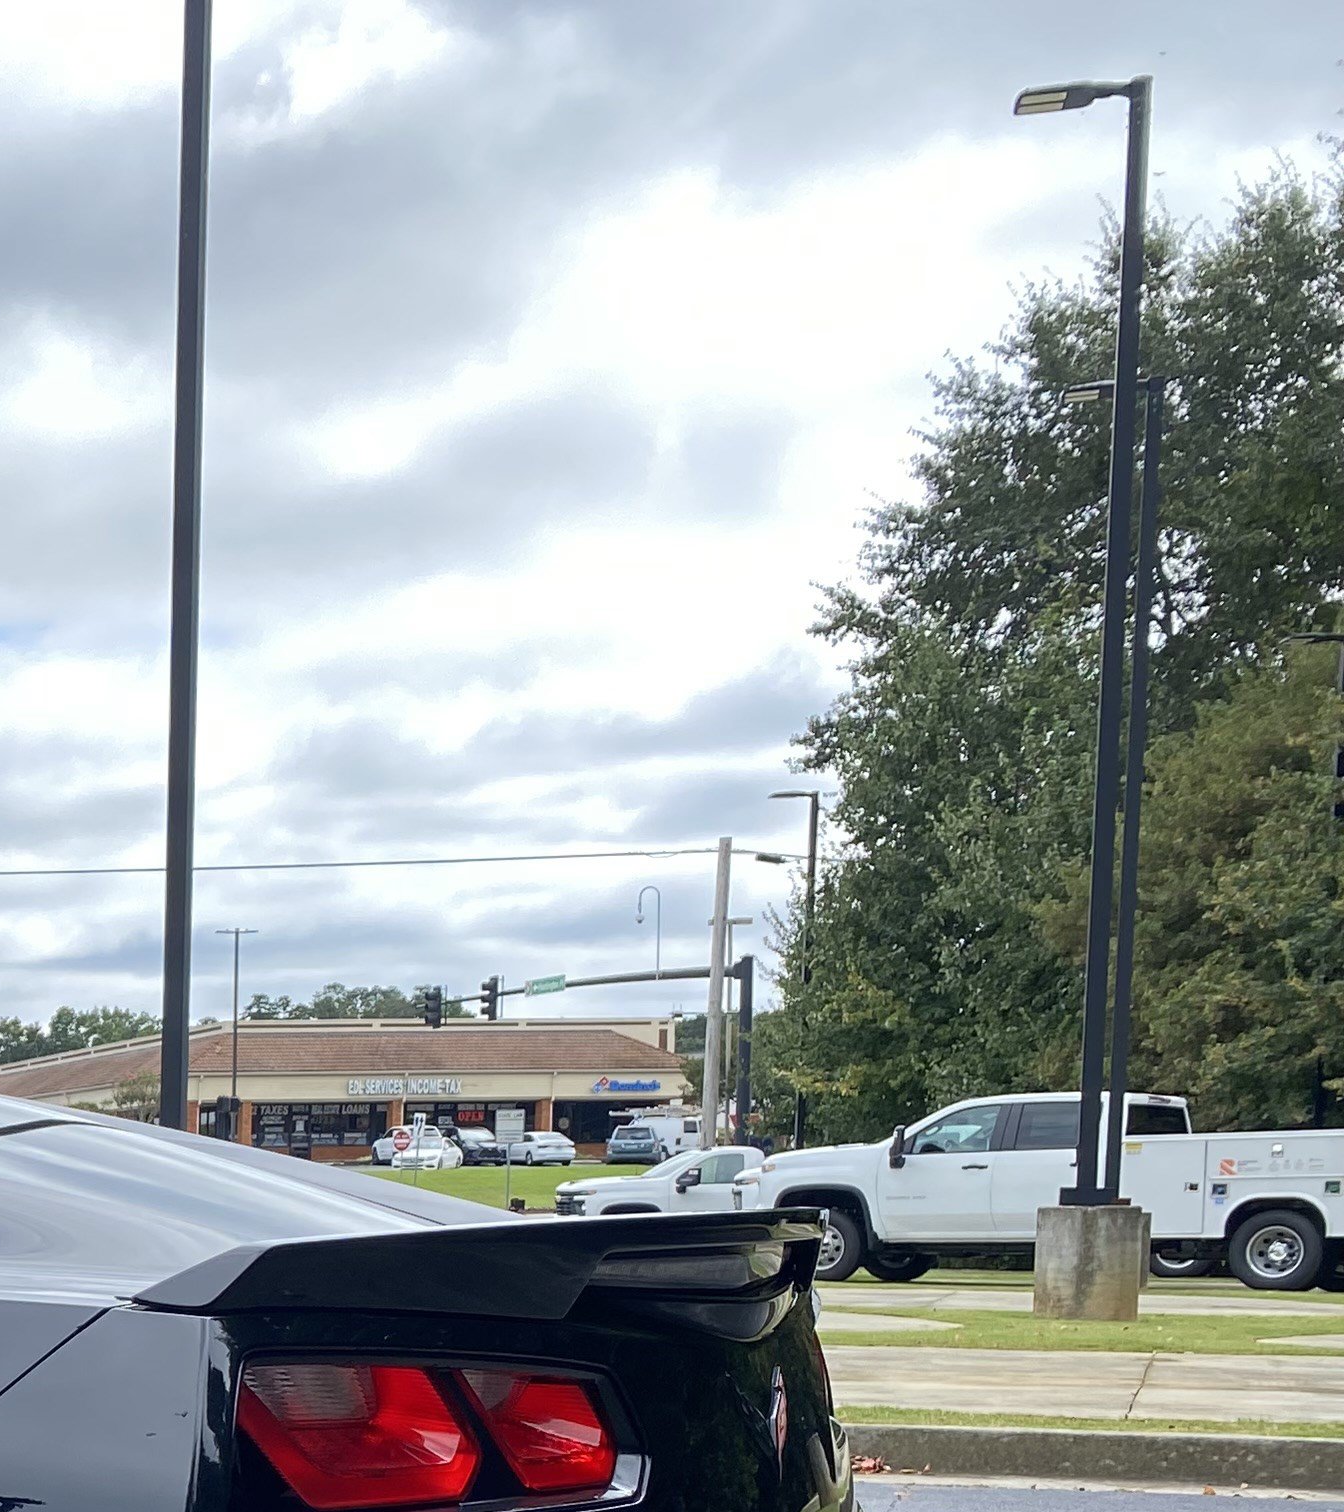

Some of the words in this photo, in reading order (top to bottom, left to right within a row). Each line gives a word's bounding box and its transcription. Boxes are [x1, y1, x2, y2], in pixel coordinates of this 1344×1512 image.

[365, 1079, 404, 1095] SERVICES
[407, 1079, 442, 1094] INCOME
[445, 1078, 462, 1094] TAX
[260, 1105, 289, 1115] TAXES
[341, 1104, 370, 1115] LOANS
[457, 1111, 485, 1121] OPEN
